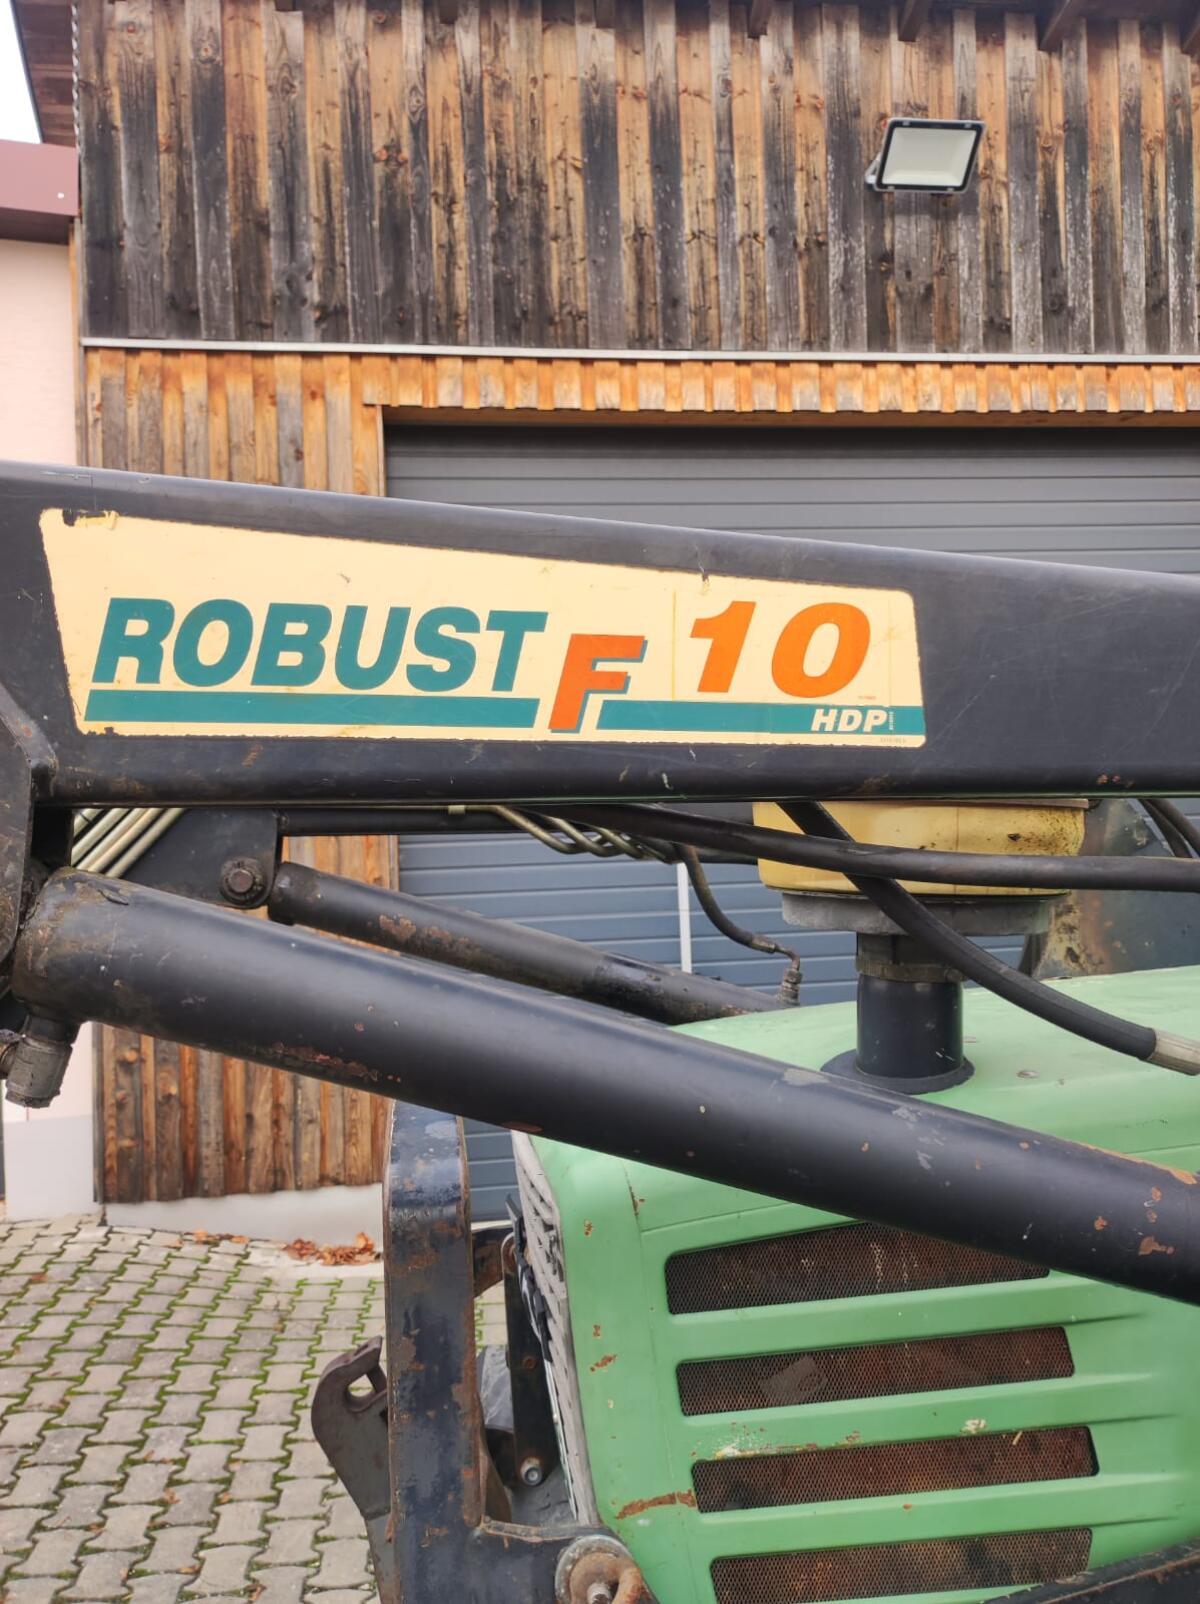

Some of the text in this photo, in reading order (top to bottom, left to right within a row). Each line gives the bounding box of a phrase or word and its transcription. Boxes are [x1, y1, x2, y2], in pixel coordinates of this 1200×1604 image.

[92, 597, 871, 733] ROBUST F 10
[811, 708, 887, 732] HDP
